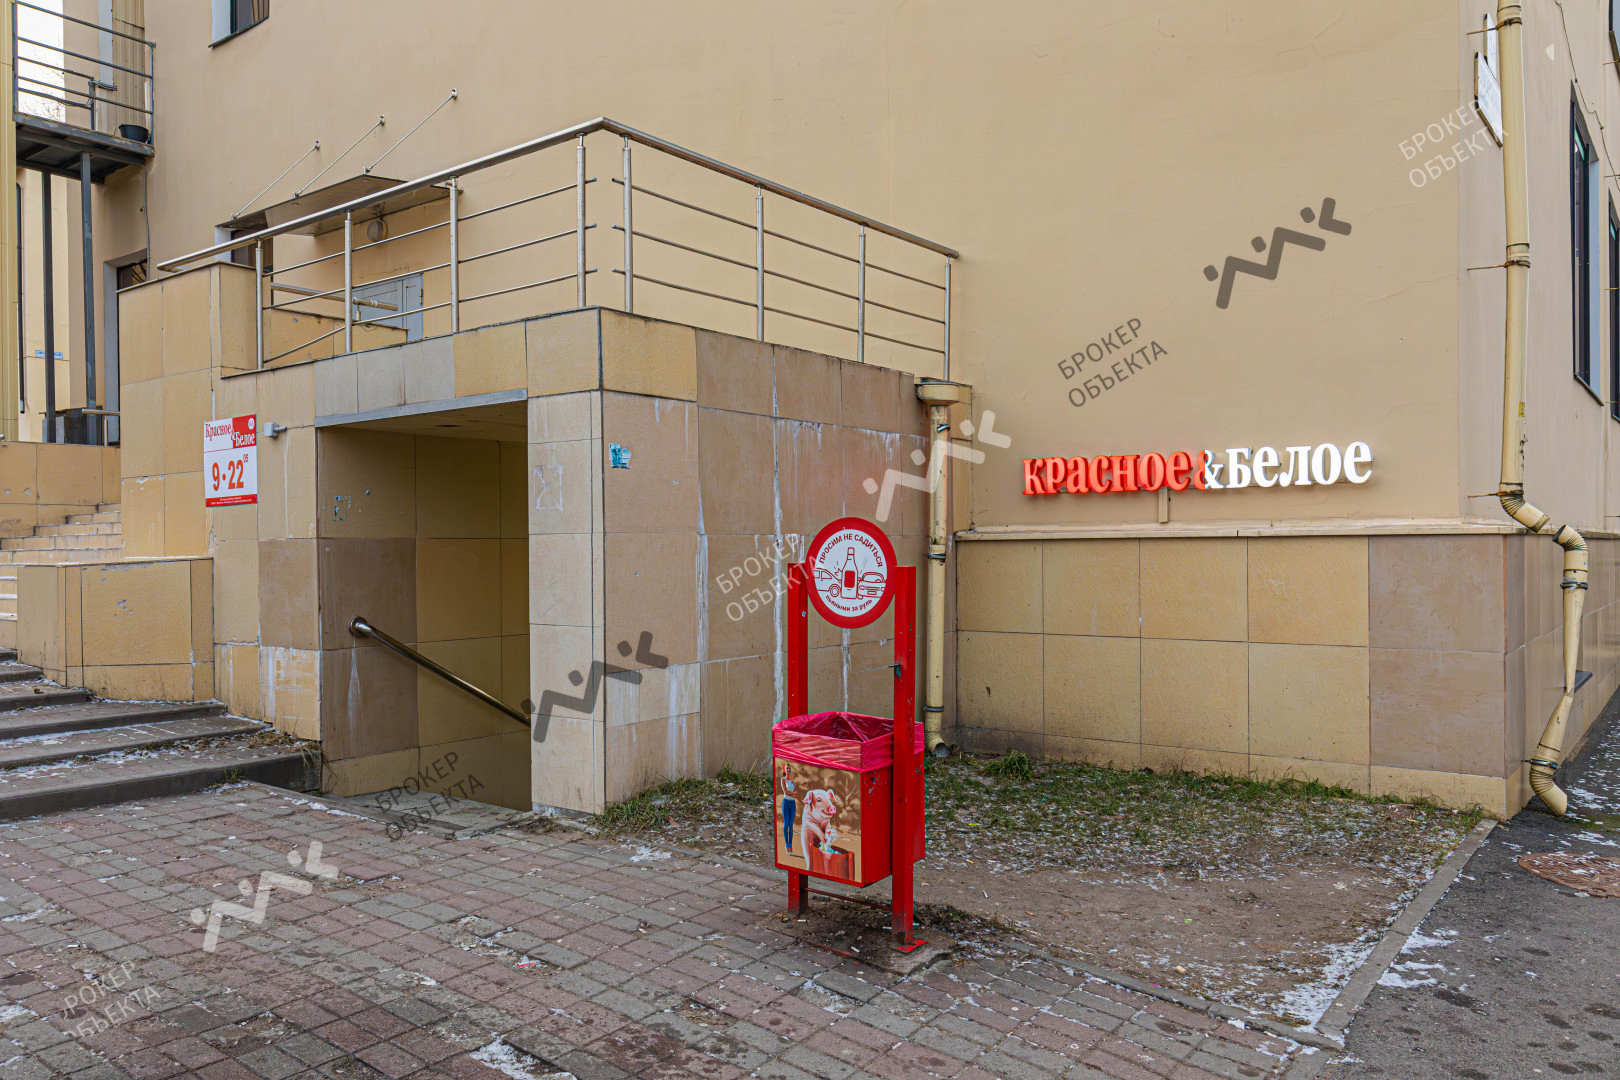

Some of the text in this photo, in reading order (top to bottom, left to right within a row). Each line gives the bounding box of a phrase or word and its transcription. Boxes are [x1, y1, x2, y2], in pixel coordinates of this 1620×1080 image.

[819, 533, 883, 567] ПРОСИМ НЕ САДИТЬСЯ
[825, 595, 851, 612] пьяными
[859, 599, 873, 611] руль
